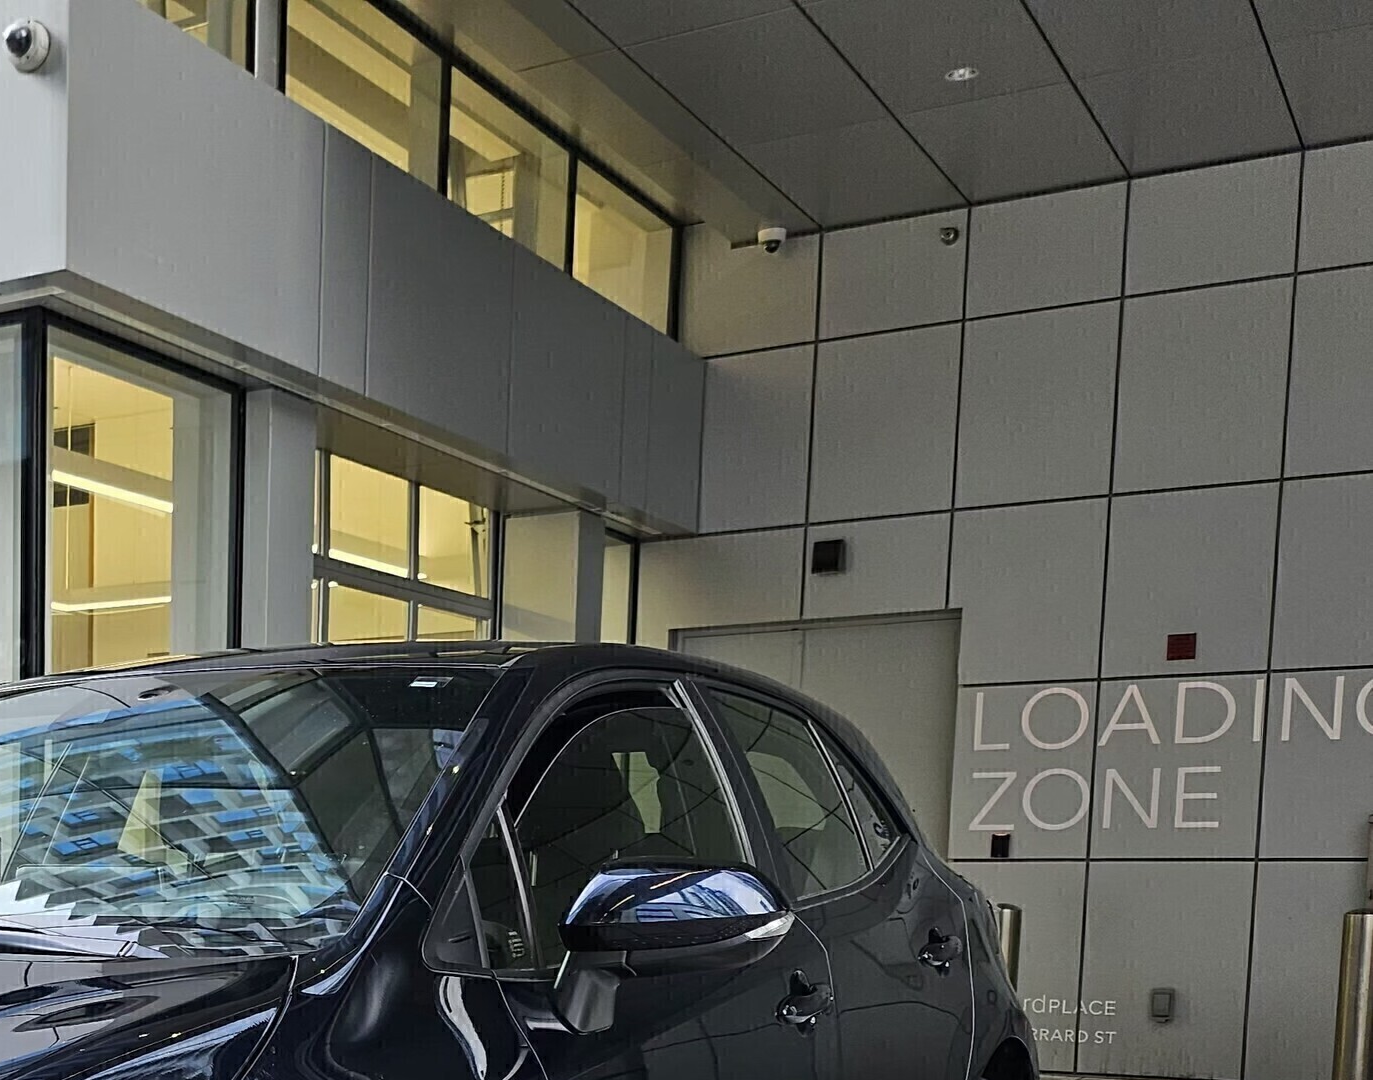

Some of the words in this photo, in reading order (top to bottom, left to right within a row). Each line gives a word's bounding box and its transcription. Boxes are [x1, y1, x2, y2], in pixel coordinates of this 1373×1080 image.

[973, 676, 1373, 752] LOADIN
[968, 765, 1223, 832] ZONE
[1094, 1030, 1118, 1044] ST
